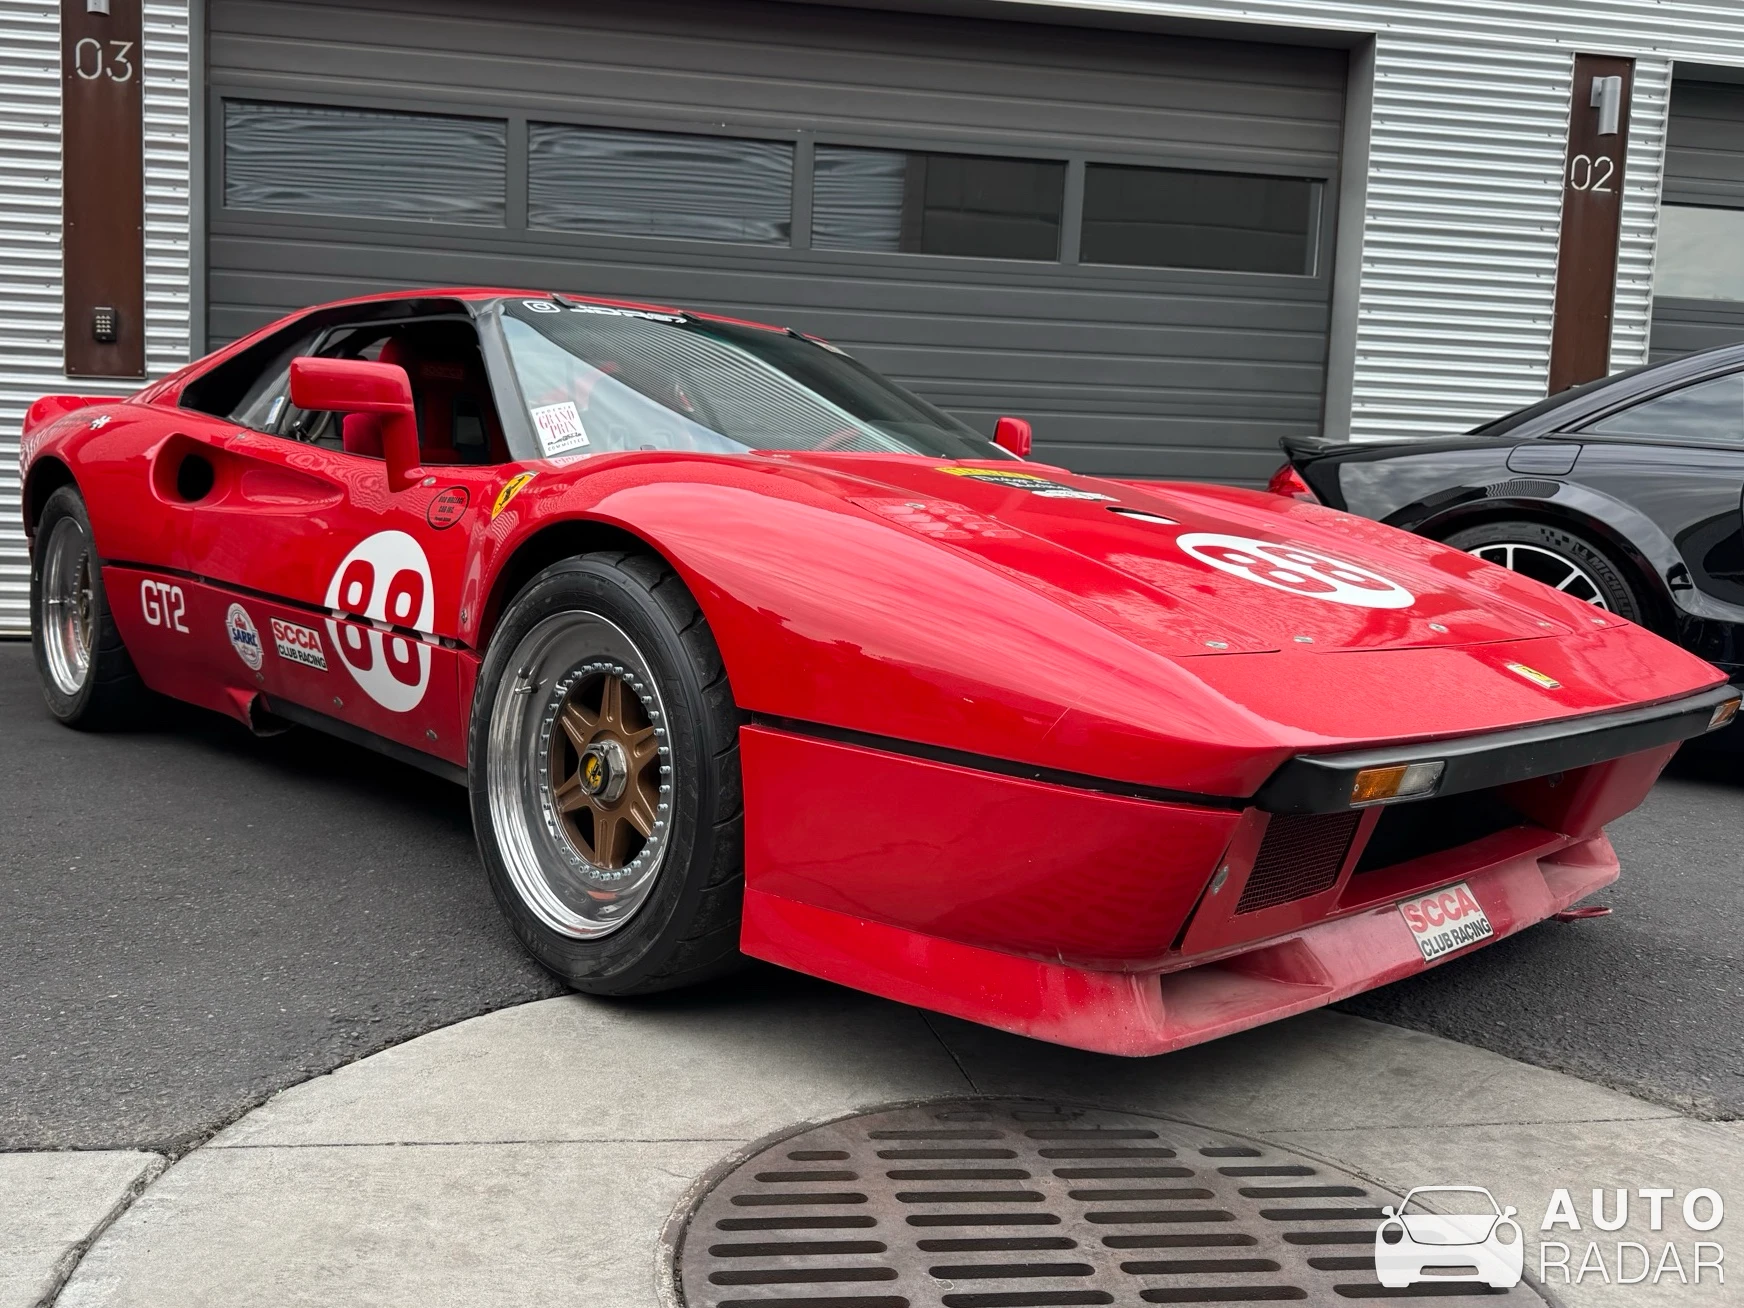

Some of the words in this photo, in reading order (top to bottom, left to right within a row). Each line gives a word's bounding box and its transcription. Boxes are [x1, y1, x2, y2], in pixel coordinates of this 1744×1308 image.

[75, 37, 134, 82] 03
[1571, 154, 1614, 192] 02
[538, 409, 575, 430] GRAND
[549, 420, 577, 439] PRIX
[547, 437, 584, 452] COMMITTEE
[1192, 545, 1396, 593] 88
[141, 579, 190, 634] GT2
[337, 559, 425, 687] 88
[273, 621, 322, 653] SCCA
[278, 645, 298, 659] CLUB
[297, 650, 327, 668] RACING
[1403, 887, 1480, 933] SCCA
[1421, 932, 1454, 957] CLUB
[1450, 918, 1492, 946] RACING
